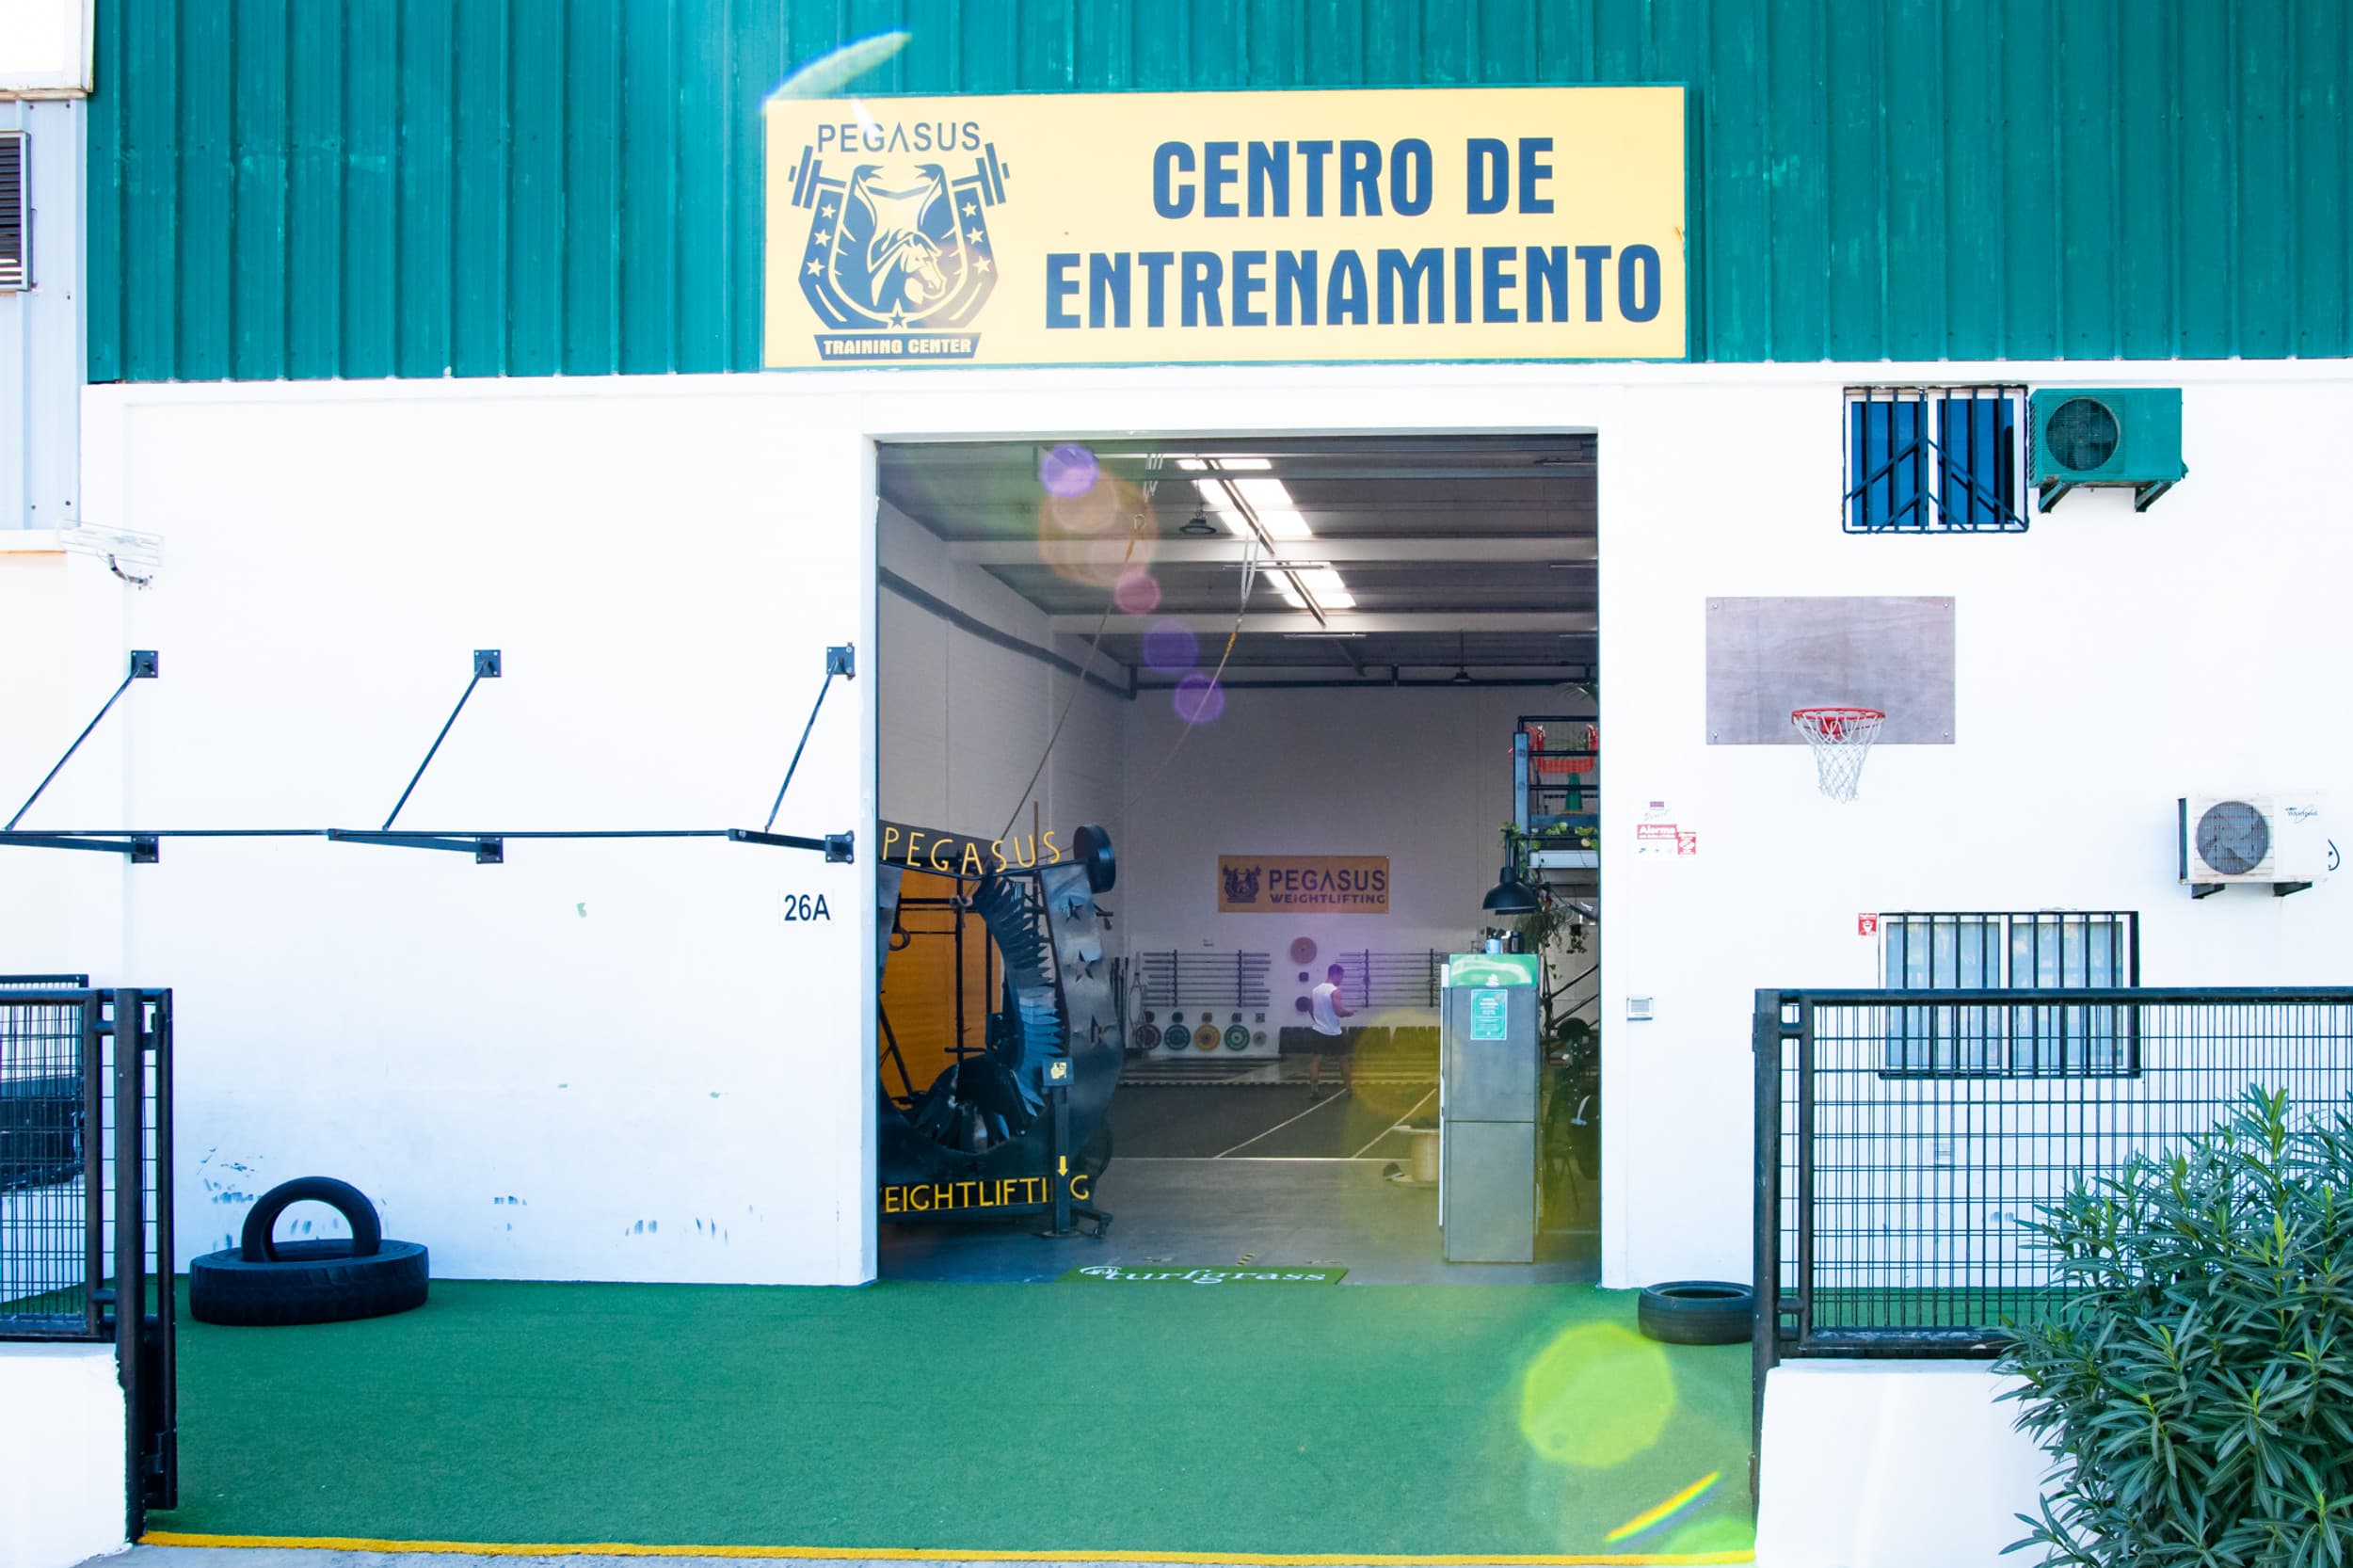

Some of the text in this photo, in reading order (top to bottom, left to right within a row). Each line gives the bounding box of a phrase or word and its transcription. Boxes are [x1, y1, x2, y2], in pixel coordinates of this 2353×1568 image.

[817, 121, 981, 152] PEGASUS
[1152, 136, 1555, 220] CENTRO DE
[1045, 243, 1662, 329] ENTRENAMIENTO
[823, 337, 972, 355] TRAINING CENTER
[882, 825, 1062, 875] PEGASUS
[1268, 868, 1386, 891] PEGASUS
[783, 893, 831, 921] 26A
[1271, 893, 1386, 904] WEIGHTLIFTING
[879, 1174, 1090, 1213] EIGHTLIFTIG
